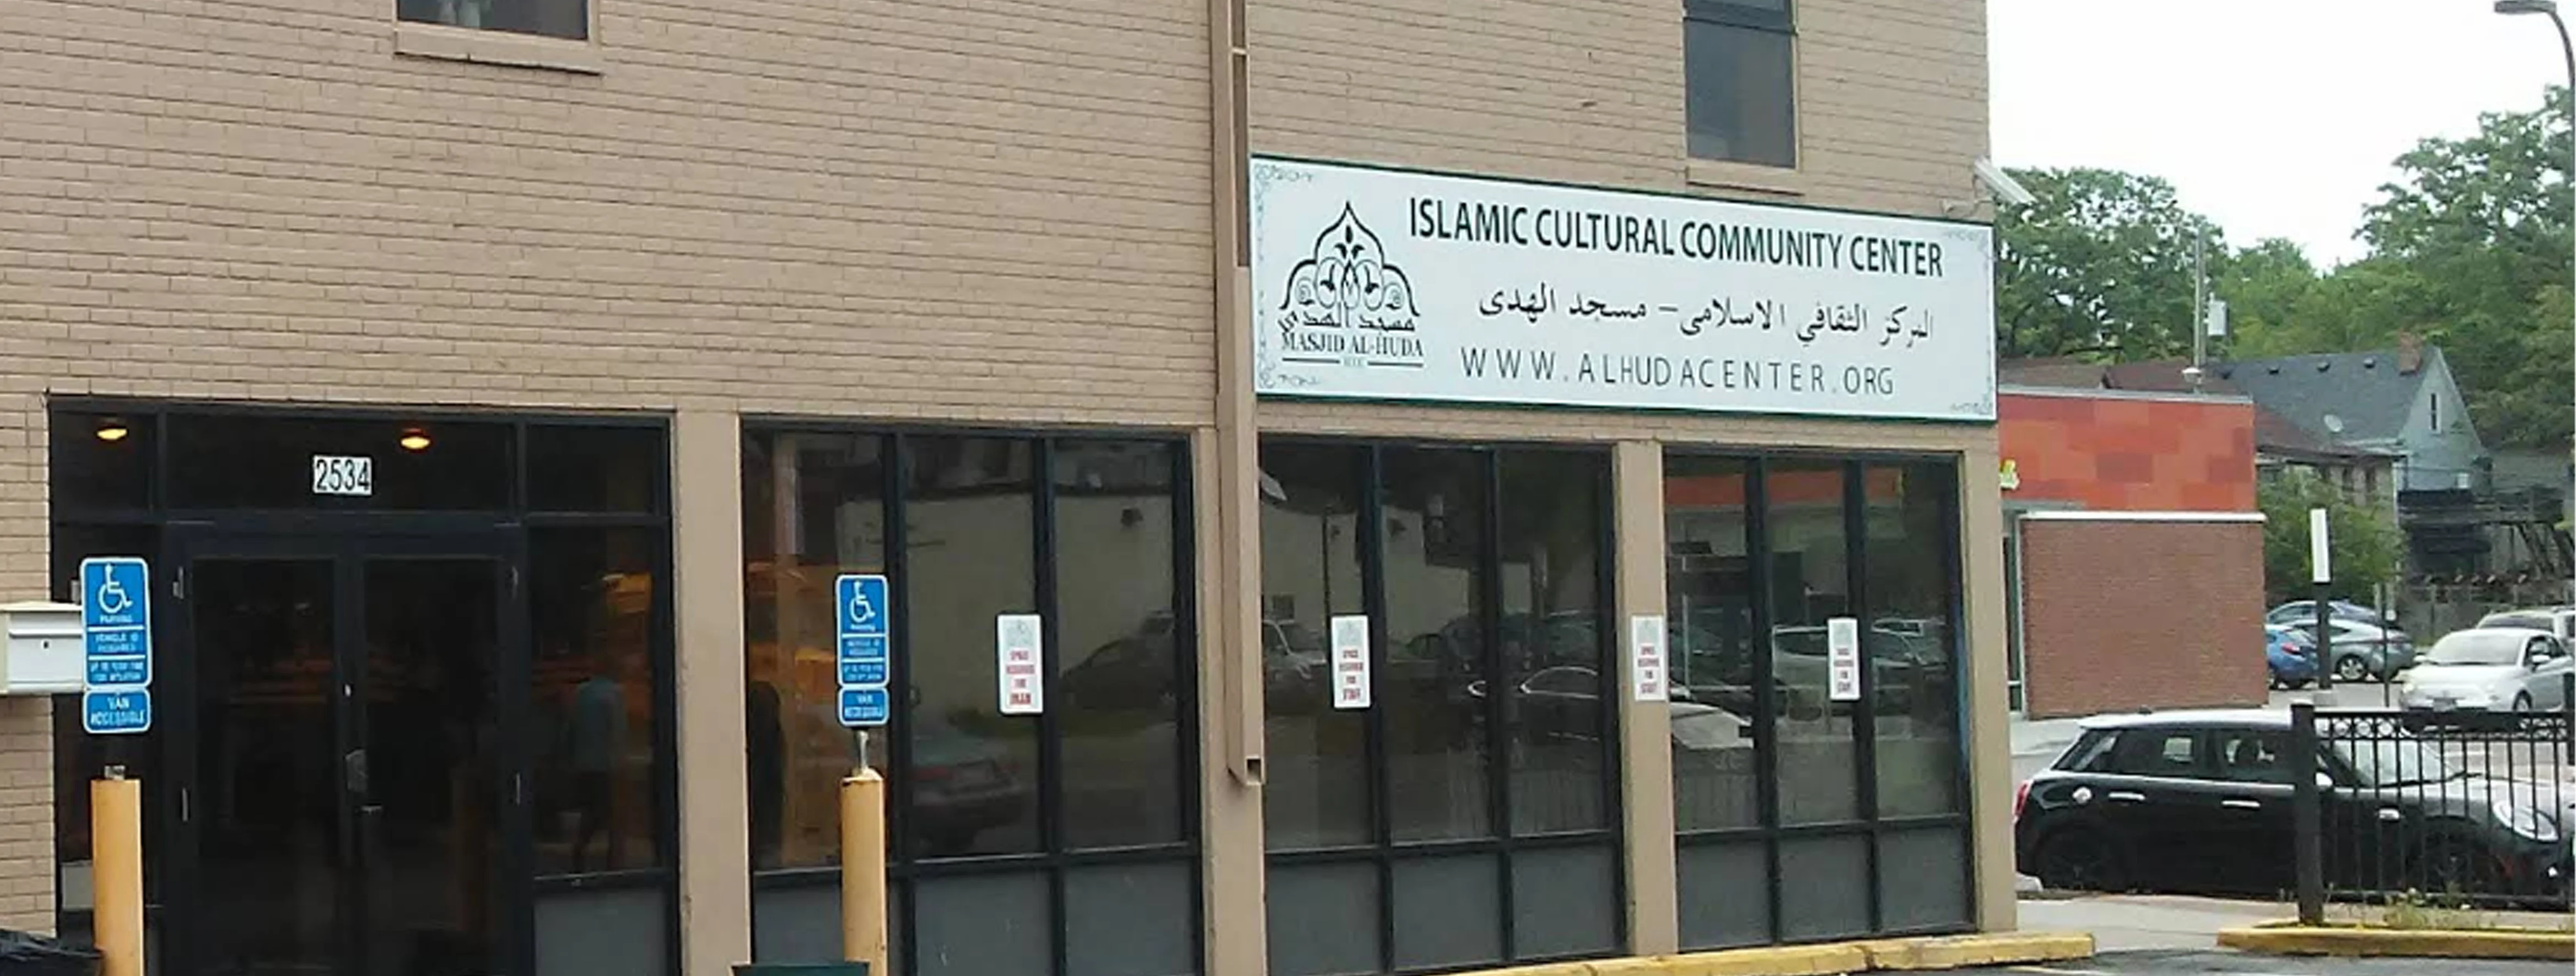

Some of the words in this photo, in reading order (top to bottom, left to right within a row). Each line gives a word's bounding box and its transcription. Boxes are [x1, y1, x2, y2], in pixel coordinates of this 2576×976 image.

[1410, 197, 1528, 245] ISLAMIC
[1535, 209, 1674, 256] CULTURAL
[1680, 221, 1843, 269] COMMUNITY
[1850, 236, 1943, 277] CENTER
[1569, 292, 1646, 322] مسجد
[1282, 332, 1345, 353] MASJID
[1350, 334, 1424, 357] AL-HUDA
[317, 459, 369, 491] 2534
